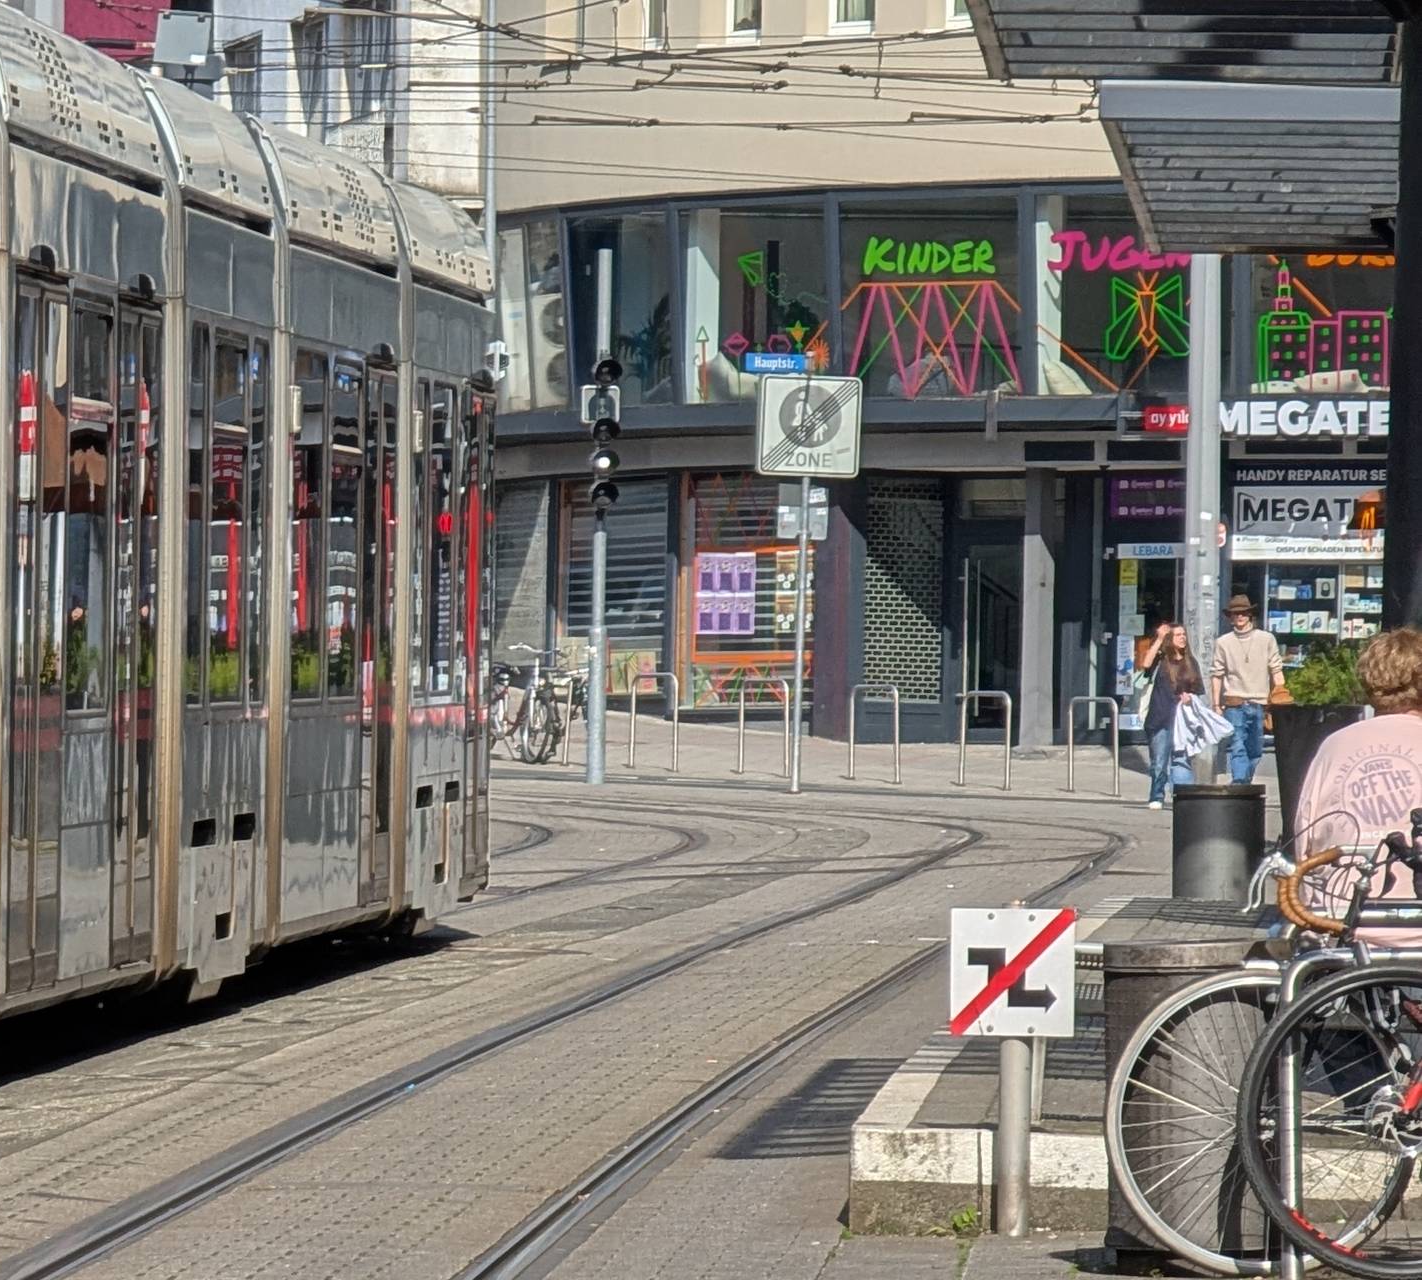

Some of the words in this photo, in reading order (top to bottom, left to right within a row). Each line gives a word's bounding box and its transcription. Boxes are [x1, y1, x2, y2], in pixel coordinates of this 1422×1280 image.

[863, 236, 996, 275] KINDER
[754, 356, 799, 370] Hauptstr.
[1220, 400, 1389, 436] MEGATE
[784, 451, 833, 468] ZONE
[1236, 469, 1285, 482] HANDY
[1287, 469, 1368, 482] REPARATUR
[1242, 498, 1358, 523] MEGAT
[1133, 546, 1174, 557] LEBARA
